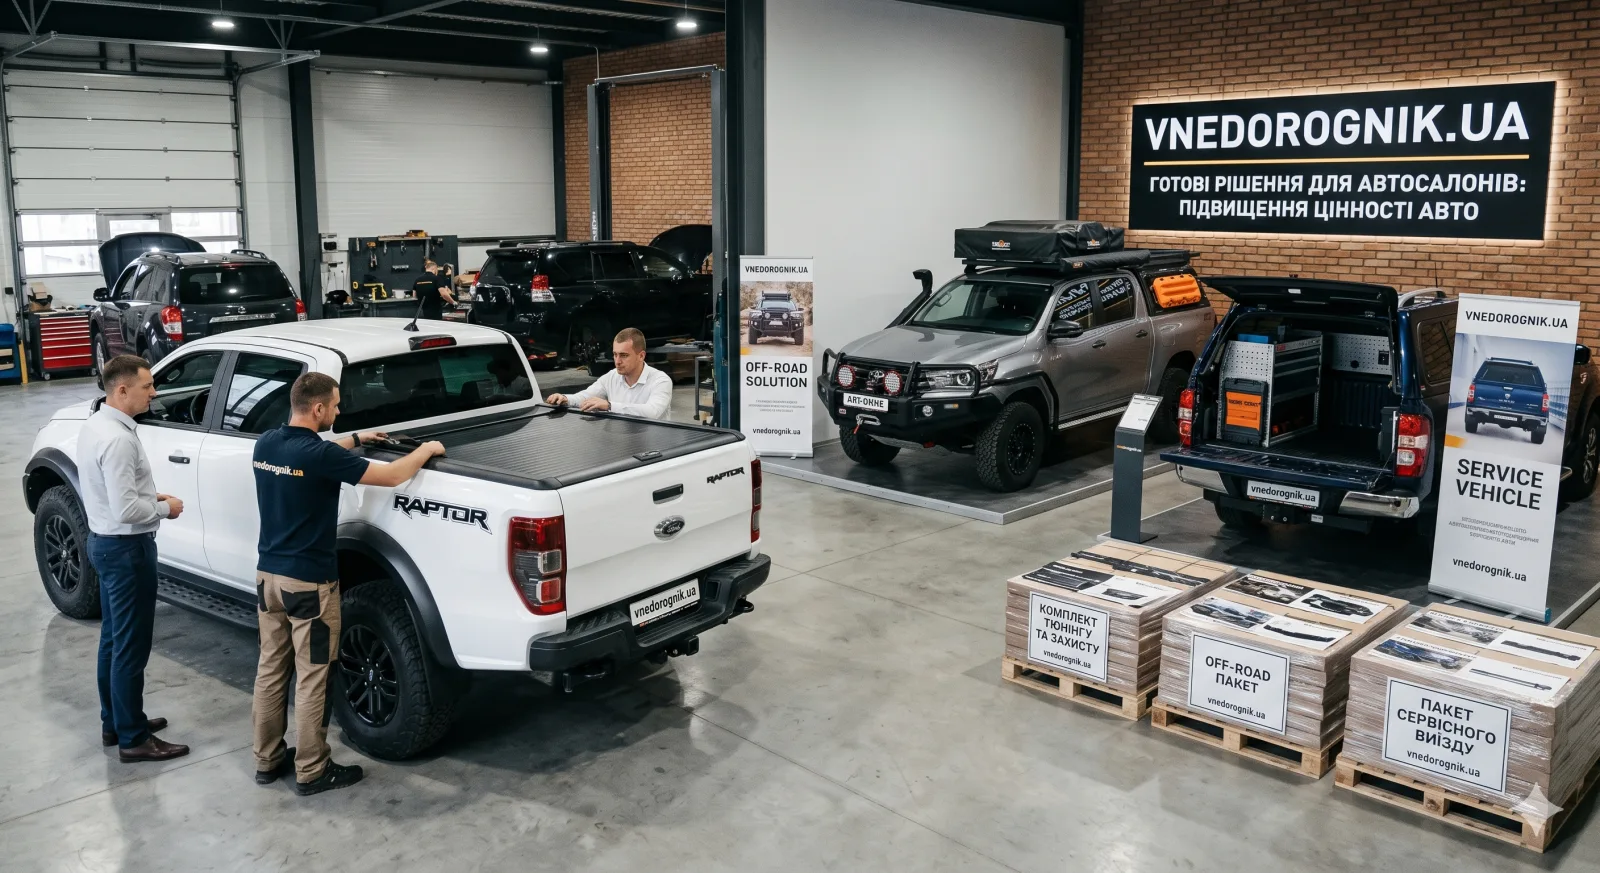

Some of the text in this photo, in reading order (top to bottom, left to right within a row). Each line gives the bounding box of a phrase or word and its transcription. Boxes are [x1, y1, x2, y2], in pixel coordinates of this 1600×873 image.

[1145, 101, 1530, 150] VNEDOROGNIK.UA
[1149, 173, 1526, 195] ГОТОВІ РІШЕННЯ ДЛЯ АВТОСАЛОНІВ:
[1179, 200, 1479, 221] ПІДВИЩЕННЯ ЦІННОСТІ АВТО
[745, 265, 808, 274] VNEDOROGNIK.UA
[1465, 310, 1568, 329] VNEDOROGNIK.UA
[745, 361, 808, 374] OFF-ROAD
[745, 376, 808, 388] SOLUTION
[752, 427, 801, 436] vnedorognik.ua
[252, 460, 304, 476] nedorognik.ua
[706, 467, 745, 484] RAPTOR
[1457, 458, 1544, 489] SERVICE
[1251, 485, 1316, 502] vnedorognik.ua
[1456, 479, 1542, 511] VEHICLE
[393, 493, 493, 535] RAPTOR
[1452, 558, 1527, 582] vnedorognik.ua
[634, 586, 697, 619] vnedorognik.ua
[1039, 603, 1098, 628] КОМПЛЕКТ
[1044, 618, 1092, 639] ТЮНІНГУ
[1036, 628, 1100, 655] ТА ЗАХИСТУ
[1043, 650, 1092, 669] vnedorognik.ua
[1205, 655, 1271, 682] OFF-ROAD
[1215, 672, 1259, 694] ПАКЕТ
[1207, 696, 1266, 720] vnedorognik.ua
[1421, 697, 1474, 722] ПАКЕТ
[1397, 708, 1496, 745] СЕРВІСНОГО
[1406, 750, 1481, 778] vnedorognik.ua
